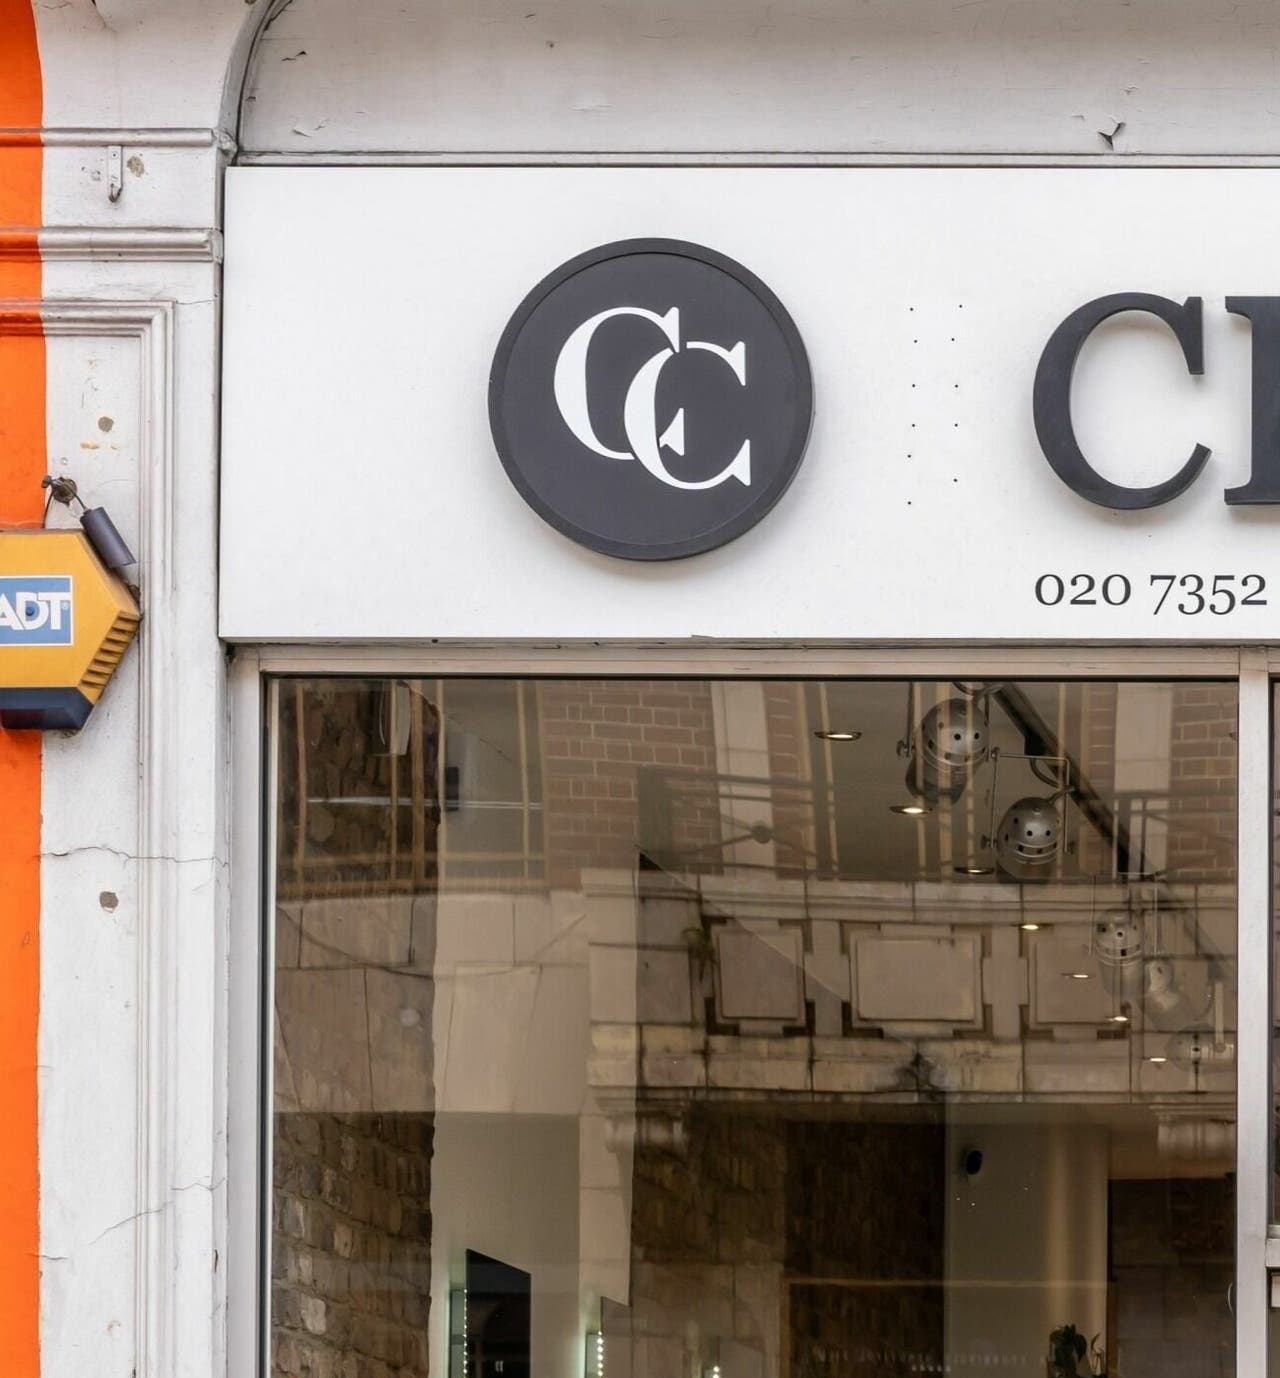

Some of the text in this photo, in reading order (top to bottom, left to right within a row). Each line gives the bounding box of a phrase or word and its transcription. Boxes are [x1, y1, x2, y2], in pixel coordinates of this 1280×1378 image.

[0, 592, 70, 630] ADT
[1035, 574, 1131, 605] 020
[1150, 574, 1267, 615] 7352
